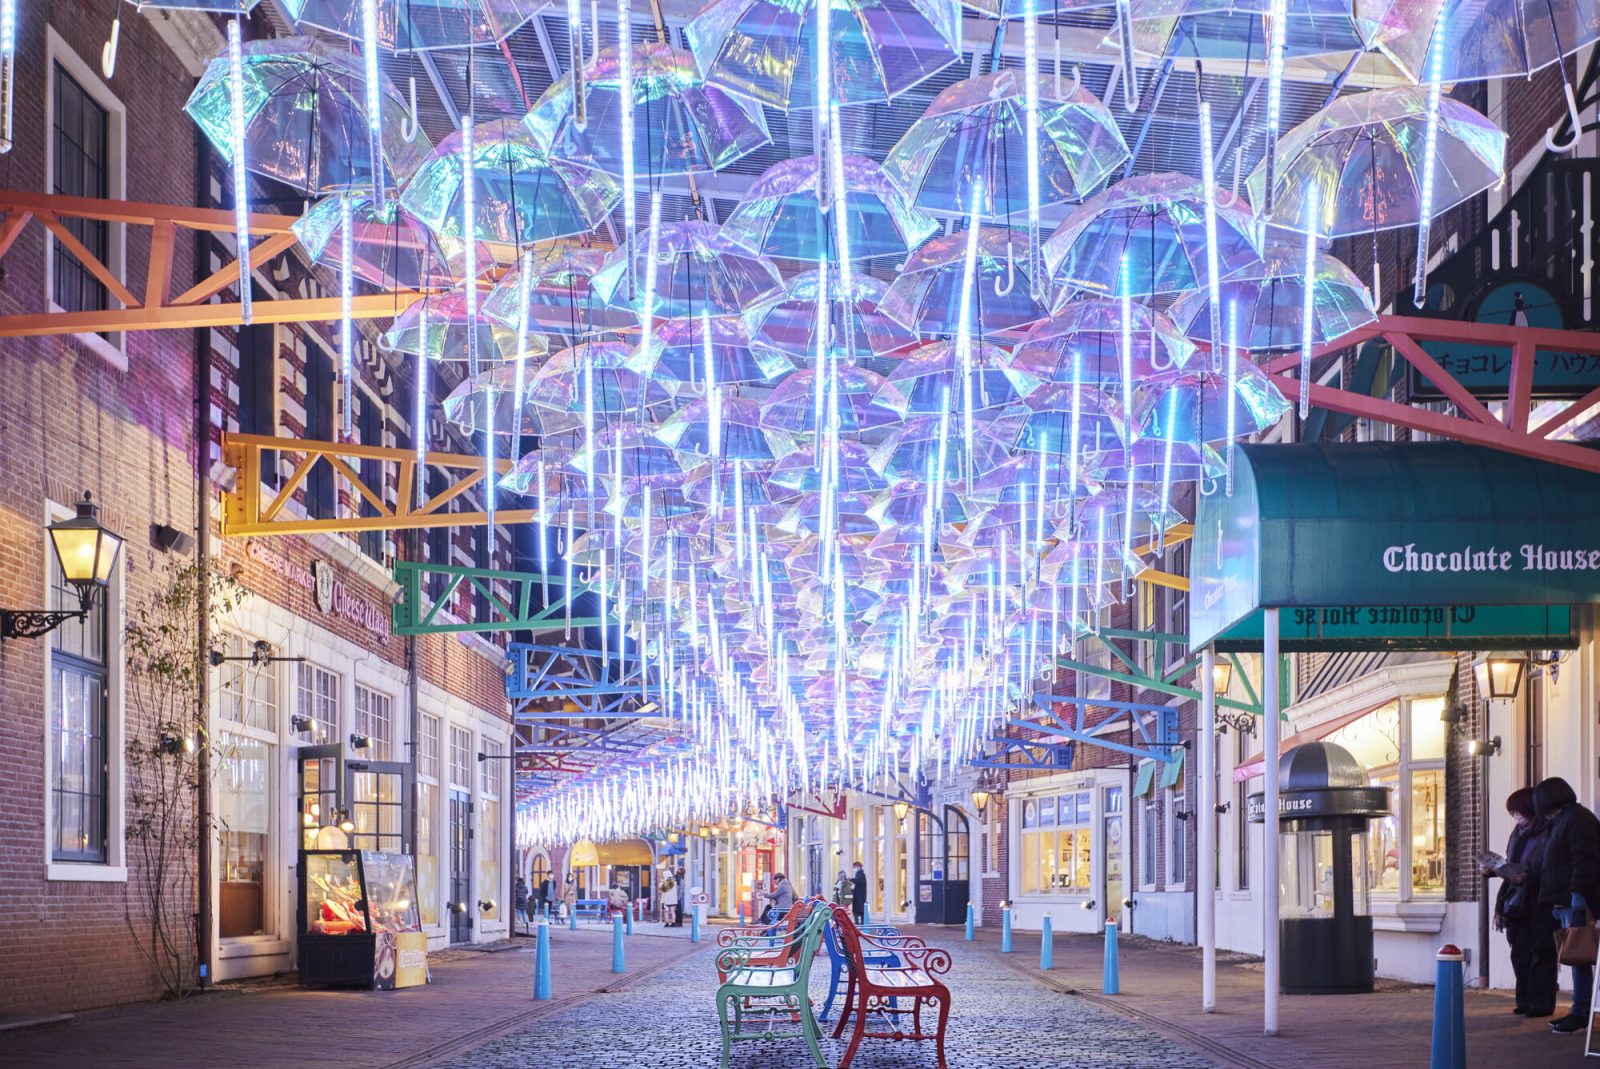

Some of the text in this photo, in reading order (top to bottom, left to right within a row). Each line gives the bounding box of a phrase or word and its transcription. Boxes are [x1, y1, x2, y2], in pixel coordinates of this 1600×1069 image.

[1435, 353, 1538, 375] チョコレ
[247, 541, 315, 592] CHEESE MARKET
[1383, 543, 1600, 572] Chocolate House
[333, 580, 365, 625] Cheese
[1279, 798, 1312, 811] House
